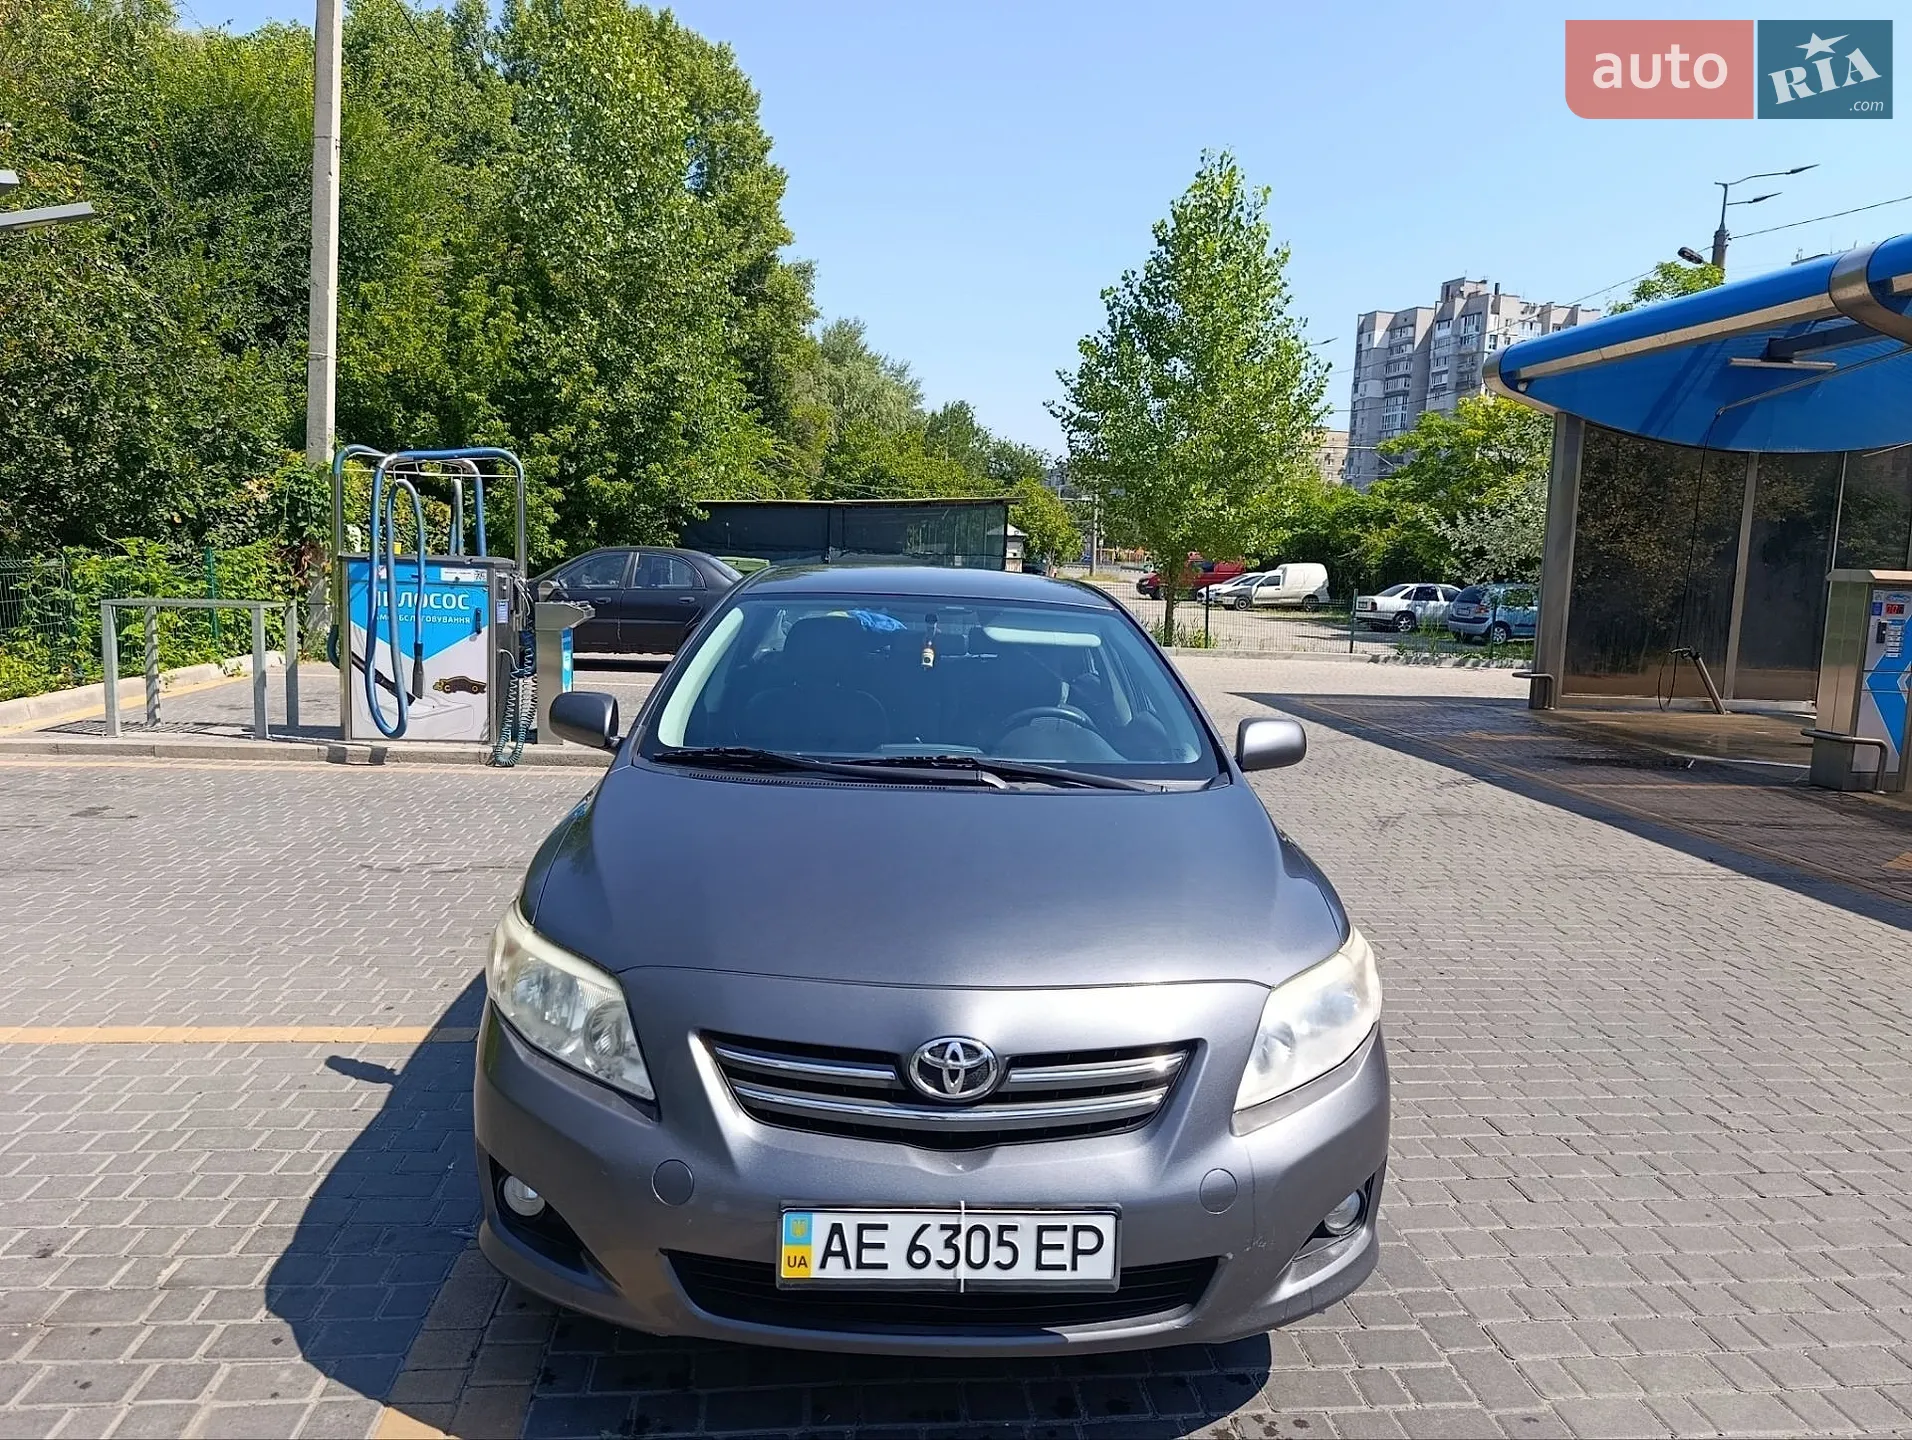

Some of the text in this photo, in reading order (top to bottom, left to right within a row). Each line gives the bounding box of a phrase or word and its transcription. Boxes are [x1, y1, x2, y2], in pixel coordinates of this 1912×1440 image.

[376, 590, 470, 610] ЛОСОС
[819, 1223, 1105, 1272] AE 6305 EP
[787, 1256, 808, 1269] UA
